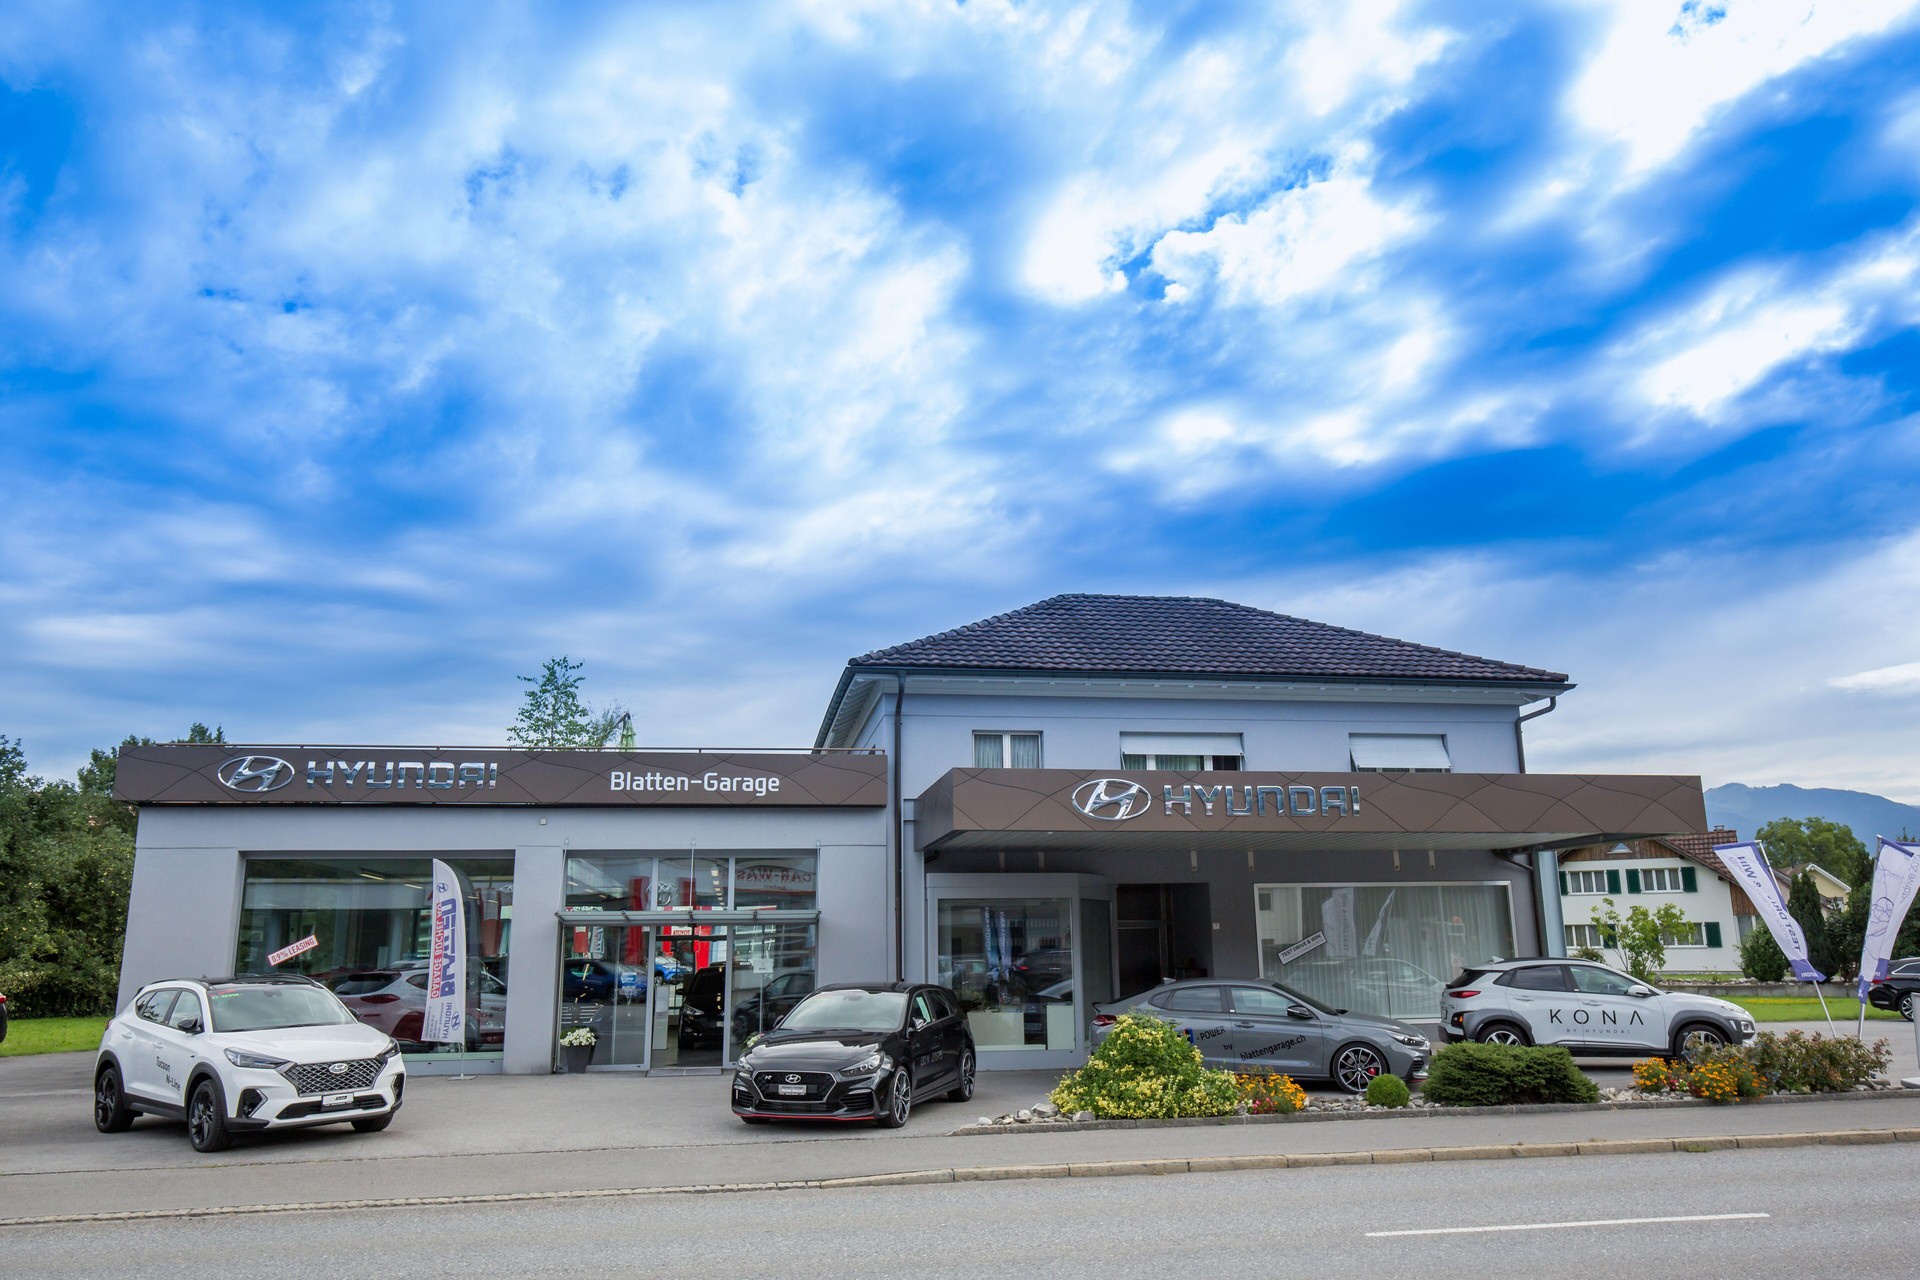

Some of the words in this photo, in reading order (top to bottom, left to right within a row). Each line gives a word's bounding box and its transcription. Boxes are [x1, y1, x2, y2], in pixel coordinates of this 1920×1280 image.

[306, 760, 498, 789] HYUNDAI
[610, 771, 780, 797] Blatten-Garage
[1163, 784, 1361, 817] HYUNDAI
[288, 938, 315, 956] LEASING
[1281, 948, 1293, 957] TEST
[1293, 940, 1308, 952] DRIVE
[1310, 933, 1322, 942] WIN
[1549, 1008, 1644, 1026] KONA
[1223, 1043, 1233, 1051] by
[1240, 1034, 1307, 1061] blattengarage.ch
[156, 1056, 170, 1072] Tucson
[166, 1074, 180, 1091] N-Line
